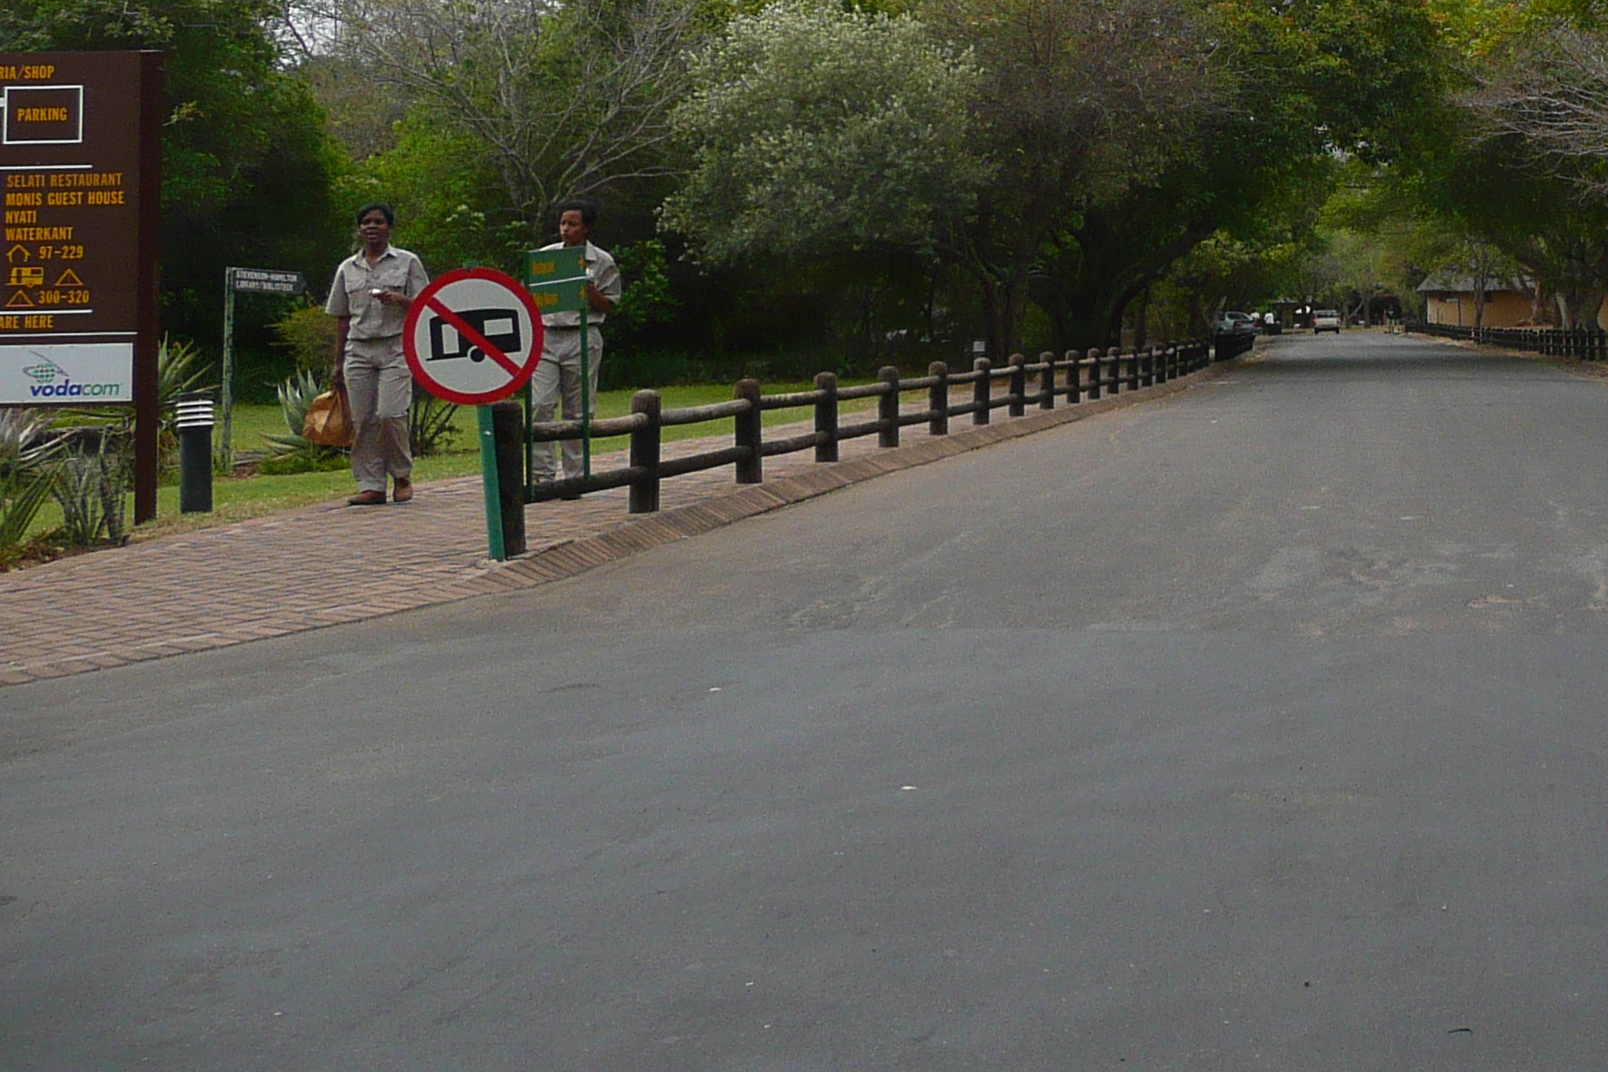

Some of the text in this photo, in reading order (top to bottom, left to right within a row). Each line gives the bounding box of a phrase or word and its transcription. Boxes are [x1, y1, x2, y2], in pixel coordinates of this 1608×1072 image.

[17, 108, 68, 121] PARKING
[7, 172, 123, 188] SELATI RESTAURANT
[5, 191, 125, 206] MONIS GUEST HOUSE
[5, 210, 37, 224] NYATI
[5, 227, 74, 241] WATERKANT
[39, 245, 84, 259] 97-229
[38, 290, 90, 304] 300-320
[25, 315, 54, 328] HERE
[30, 378, 120, 397] vodacom
